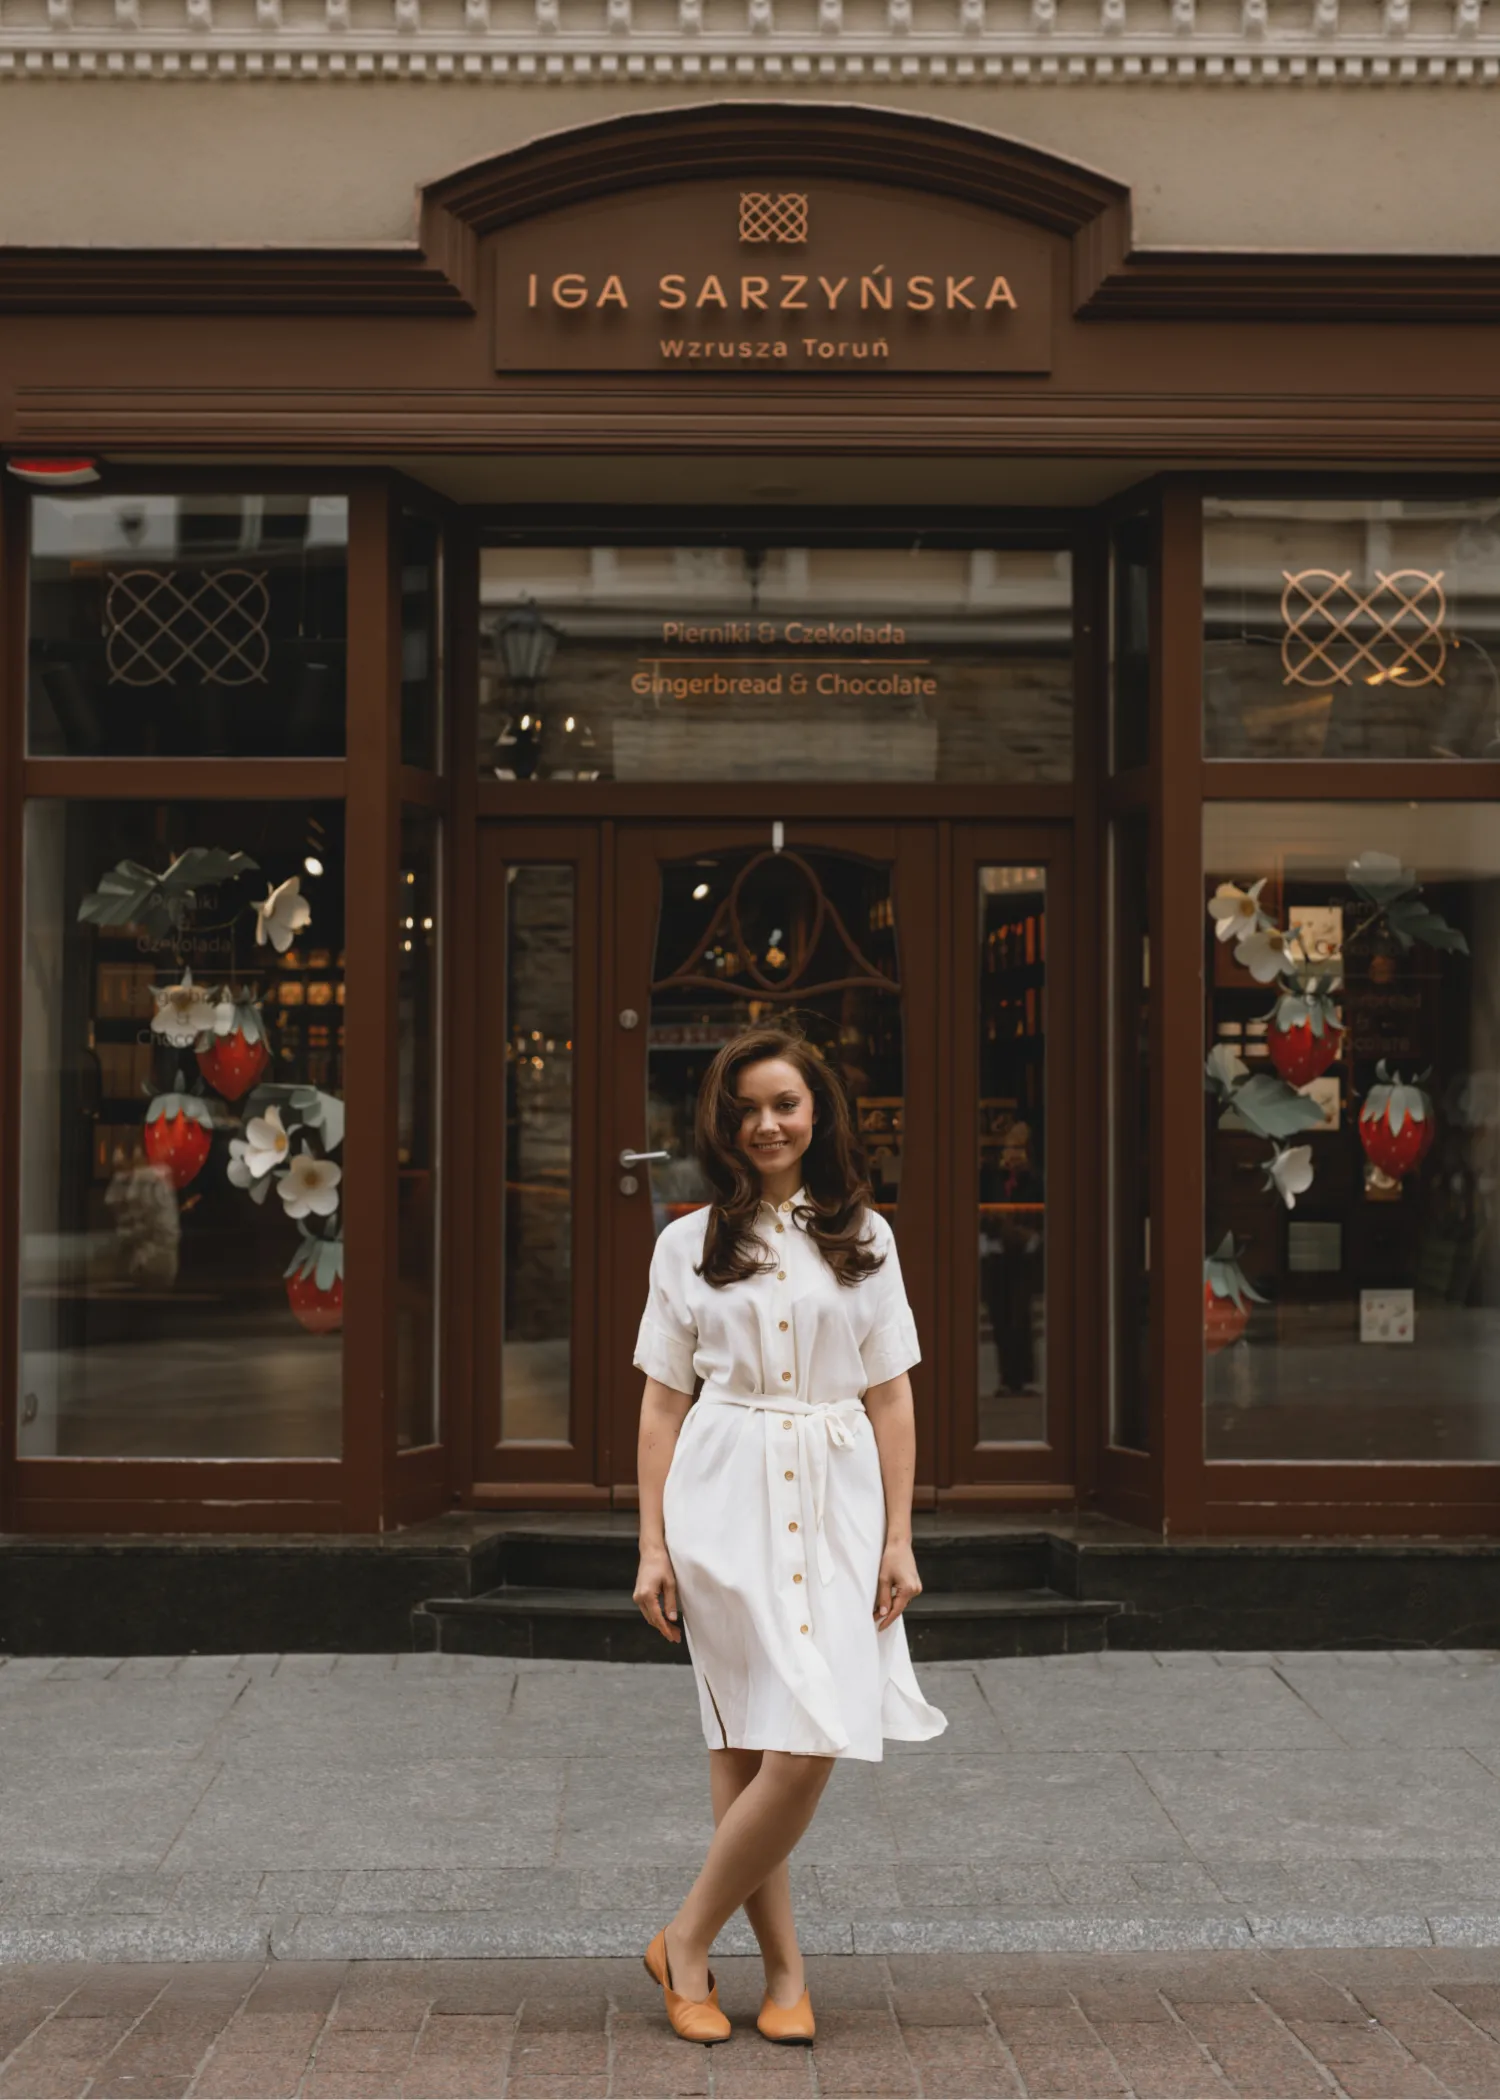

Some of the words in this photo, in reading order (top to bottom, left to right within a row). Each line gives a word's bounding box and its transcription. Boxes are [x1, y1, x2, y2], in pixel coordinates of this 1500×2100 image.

[528, 273, 629, 310] IGA
[658, 263, 1019, 311] SARZYŃSKA
[659, 339, 788, 359] Wzrusza
[802, 337, 889, 359] Toruń
[662, 621, 751, 644] Pierniki
[757, 621, 776, 644] &
[784, 621, 906, 645] Czekolada
[630, 672, 783, 700] Gingerbread
[788, 672, 808, 695] &
[816, 672, 938, 696] Chocolate
